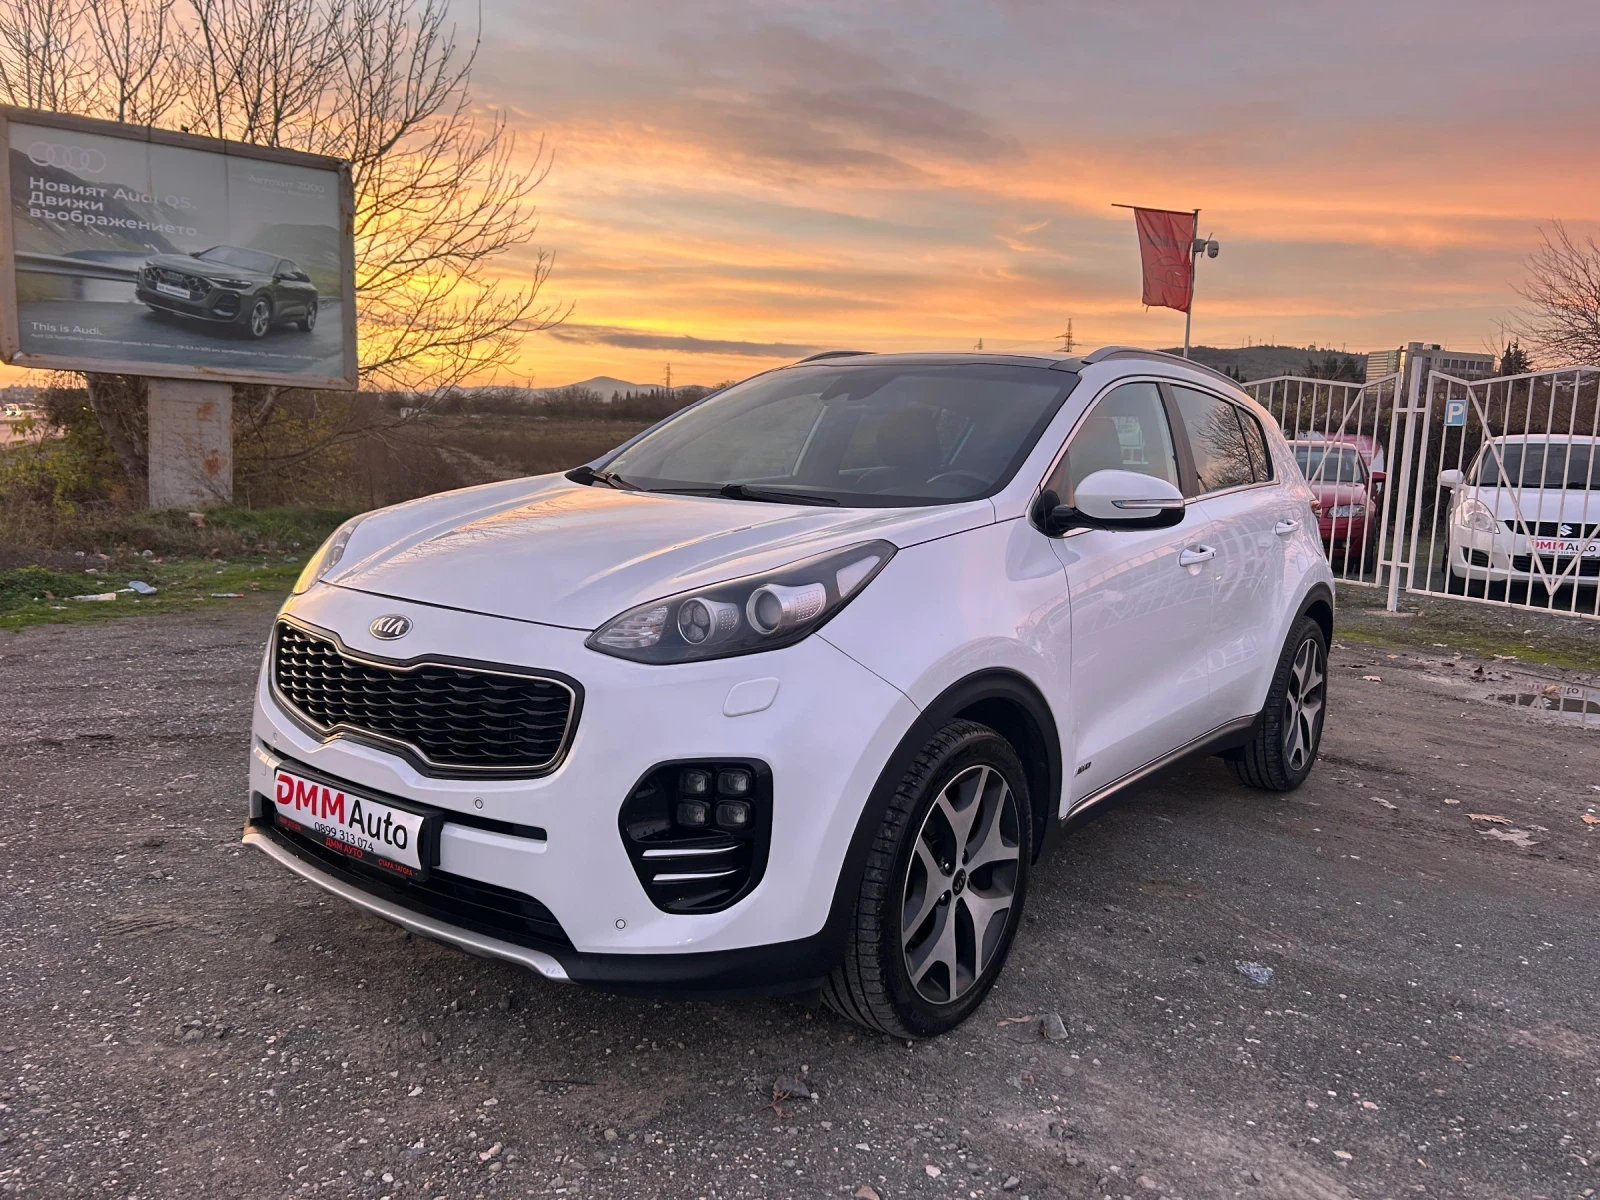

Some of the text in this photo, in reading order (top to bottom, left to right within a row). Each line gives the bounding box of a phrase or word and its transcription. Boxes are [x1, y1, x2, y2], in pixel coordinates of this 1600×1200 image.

[29, 176, 107, 198] Новият
[28, 191, 104, 211] Движи
[31, 321, 57, 332] This
[60, 323, 69, 333] is
[1447, 403, 1463, 423] P
[373, 616, 405, 635] KIA
[314, 821, 337, 838] 0899
[339, 829, 356, 845] 313
[357, 837, 375, 853] 074
[325, 836, 363, 859] ДММ АУТО
